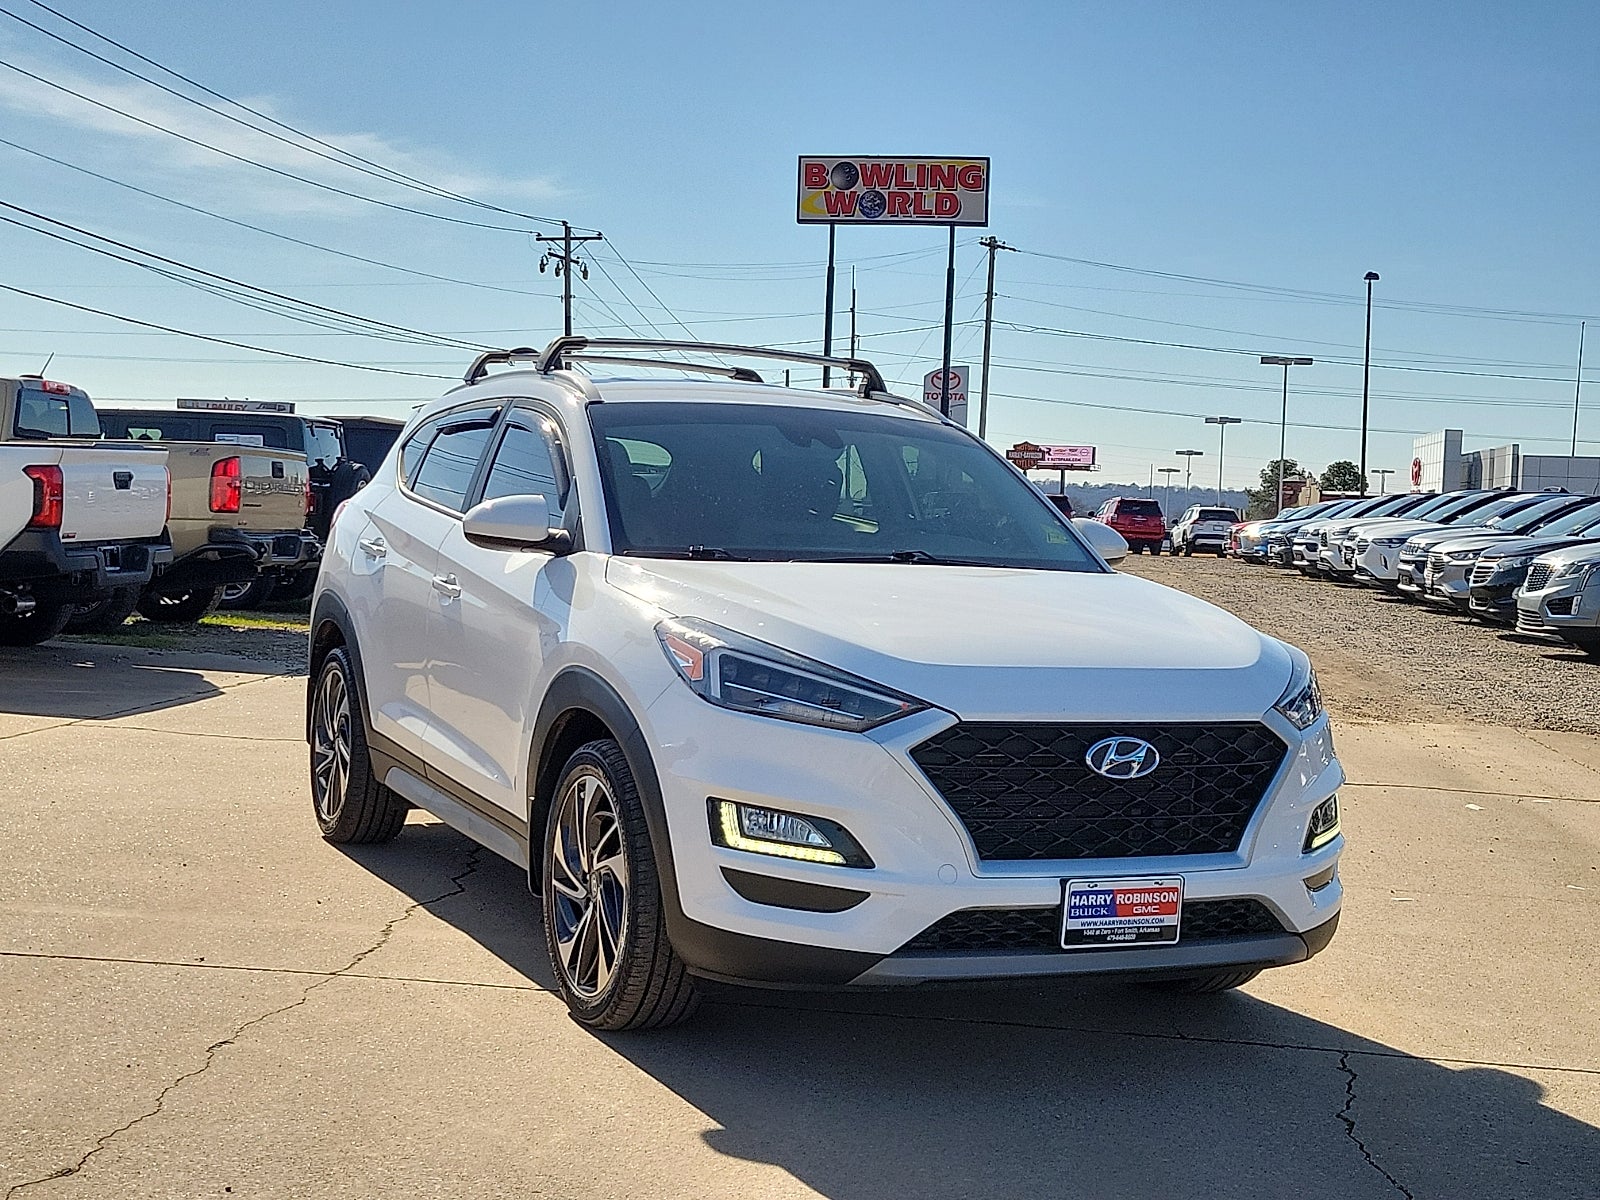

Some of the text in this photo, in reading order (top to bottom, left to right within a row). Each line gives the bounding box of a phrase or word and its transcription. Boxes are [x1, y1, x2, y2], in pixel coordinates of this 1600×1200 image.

[804, 161, 984, 191] BOWLING
[823, 190, 962, 219] WORLD
[1070, 891, 1177, 906] HARRY ROBINSON
[1070, 905, 1160, 916] BUICK GMC
[1080, 918, 1164, 927] WWW.HARRYROBINSON.COM
